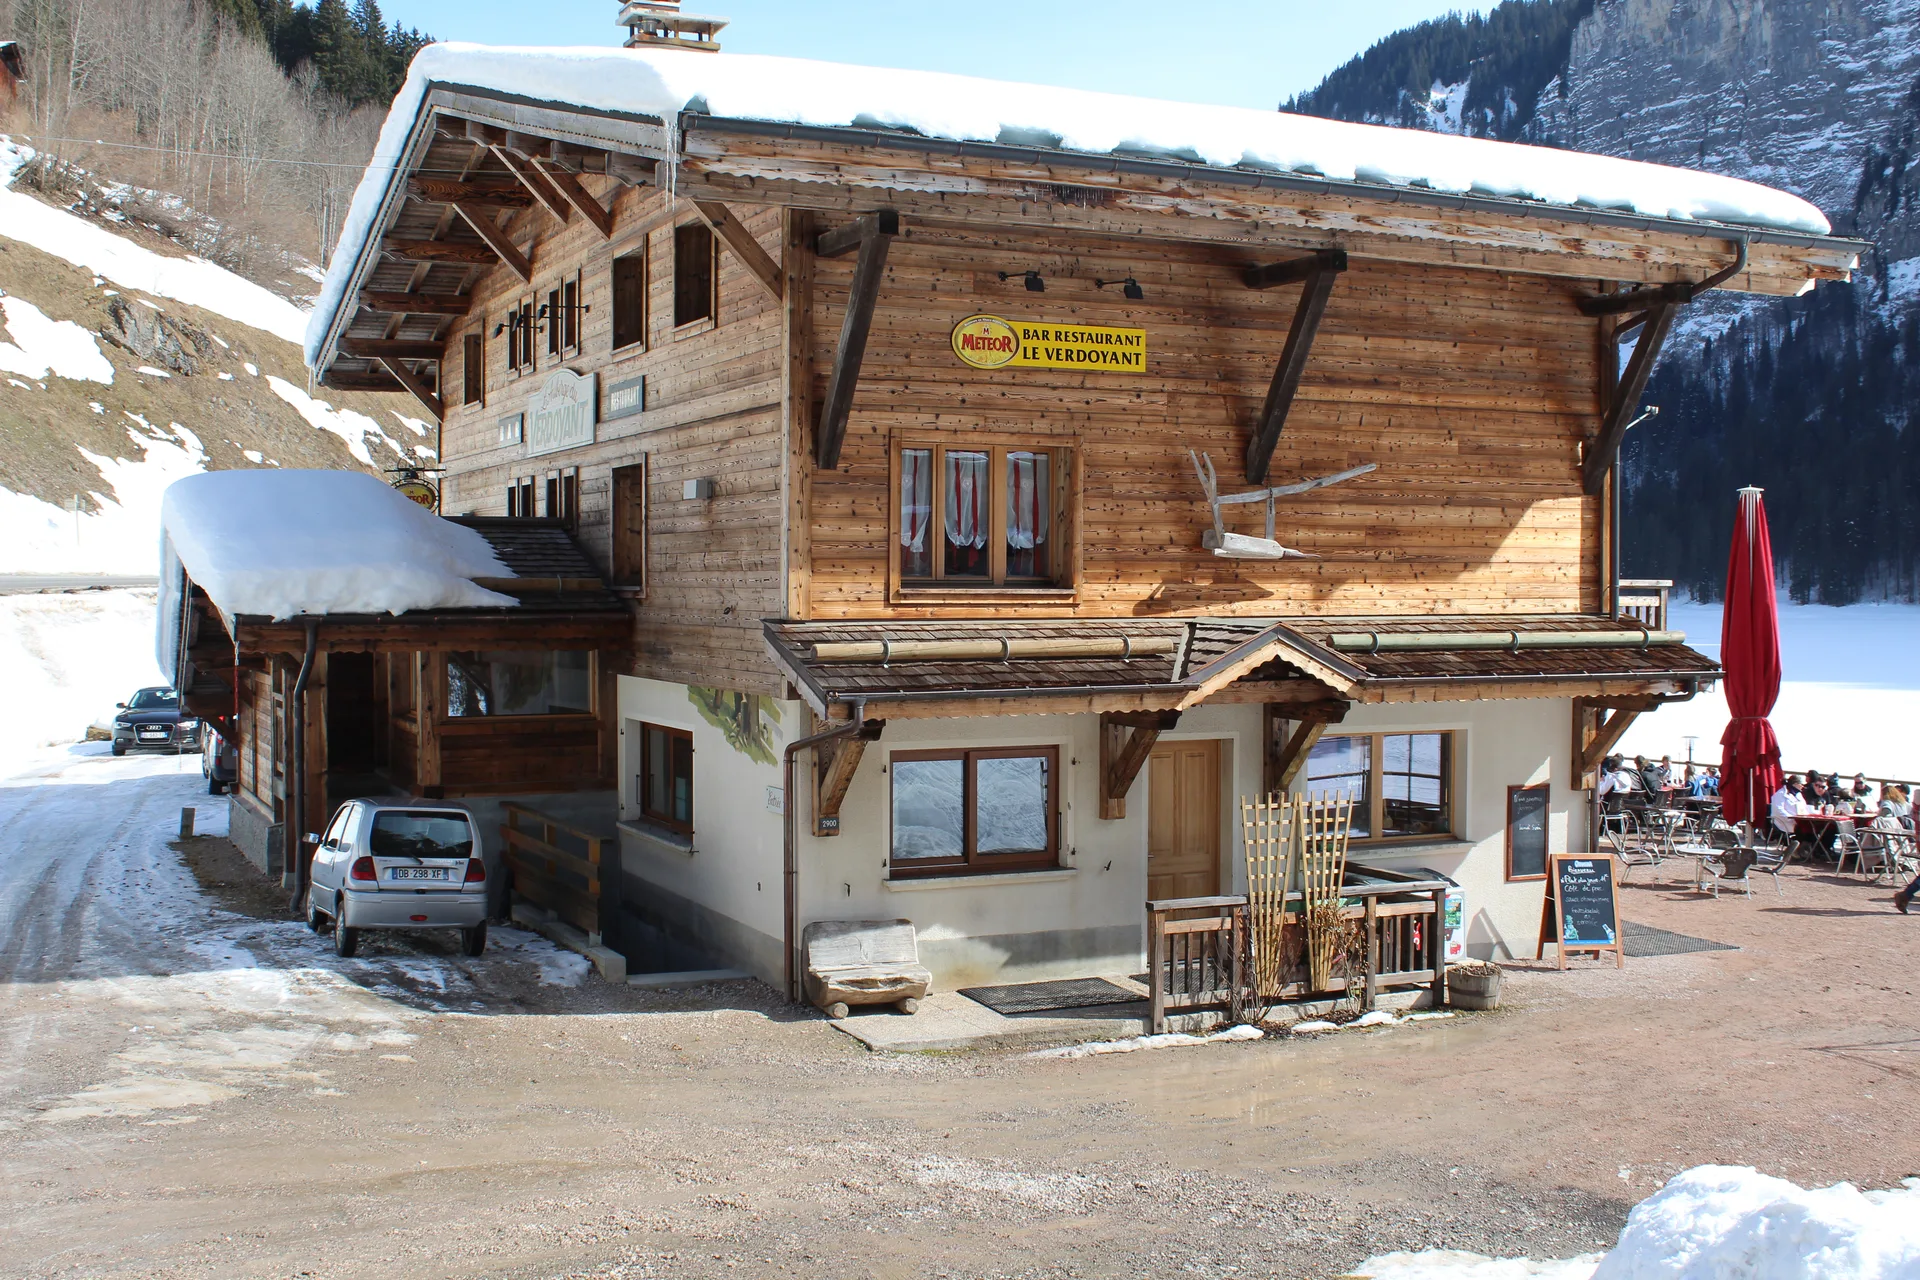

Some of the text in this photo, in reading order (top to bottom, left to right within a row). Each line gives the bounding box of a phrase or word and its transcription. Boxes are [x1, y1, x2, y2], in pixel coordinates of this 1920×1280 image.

[961, 333, 1013, 352] METEOR
[1023, 328, 1142, 346] BAR RESTAURANT
[1023, 346, 1142, 366] LE VERDOYANT
[529, 398, 588, 454] VERDOYANT
[822, 820, 837, 828] 2900
